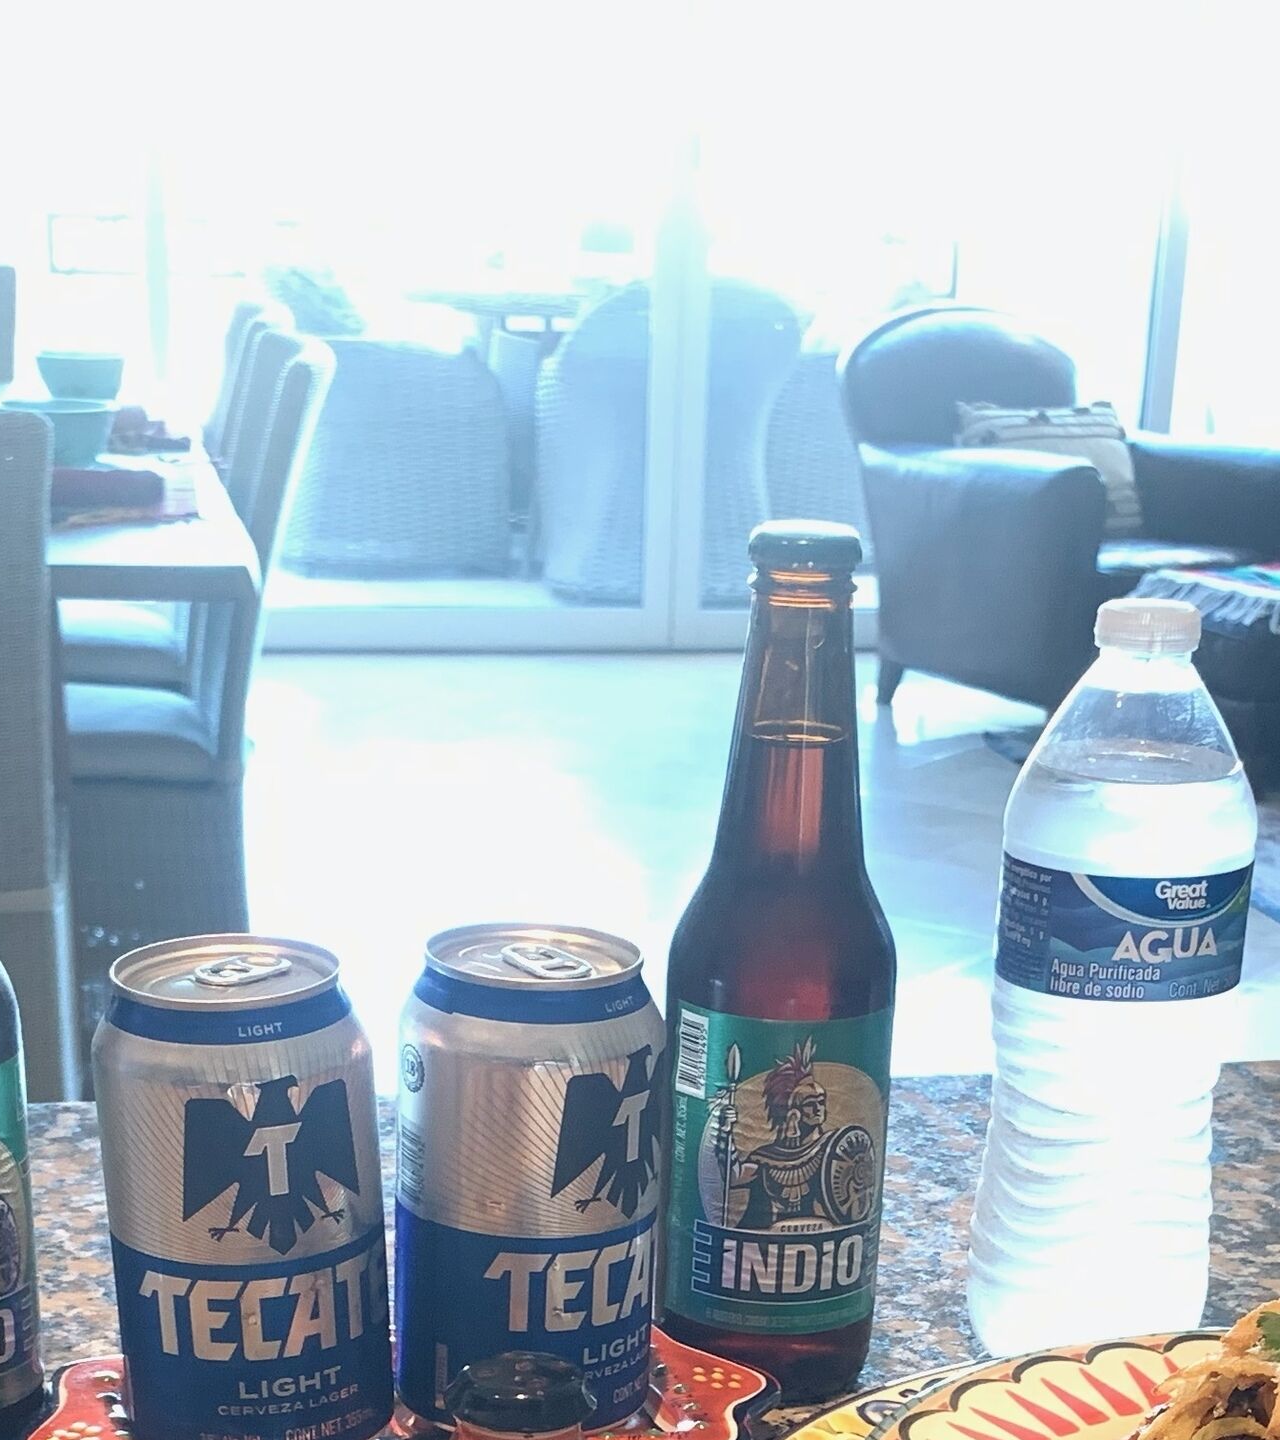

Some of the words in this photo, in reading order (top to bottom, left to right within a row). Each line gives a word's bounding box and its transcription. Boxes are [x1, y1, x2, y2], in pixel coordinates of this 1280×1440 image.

[1155, 880, 1208, 899] Great
[1111, 927, 1218, 965] AGUA
[1051, 958, 1084, 978] Agua
[1089, 962, 1160, 981] Purificada
[1050, 975, 1080, 995] libre
[1084, 982, 1102, 997] de
[1105, 983, 1145, 999] sodio
[604, 995, 633, 1013] LIGHT
[238, 1022, 283, 1038] LIGHT
[612, 1089, 651, 1163] T
[243, 1121, 302, 1196] T
[780, 1223, 824, 1233] CERVEZA
[721, 1234, 864, 1294] INDIO
[583, 1322, 648, 1365] LIGHT
[238, 1366, 342, 1400] LIGHT
[584, 1361, 629, 1380] RVEZA
[217, 1401, 304, 1416] CERVEZA
[309, 1383, 360, 1408] LAGER
